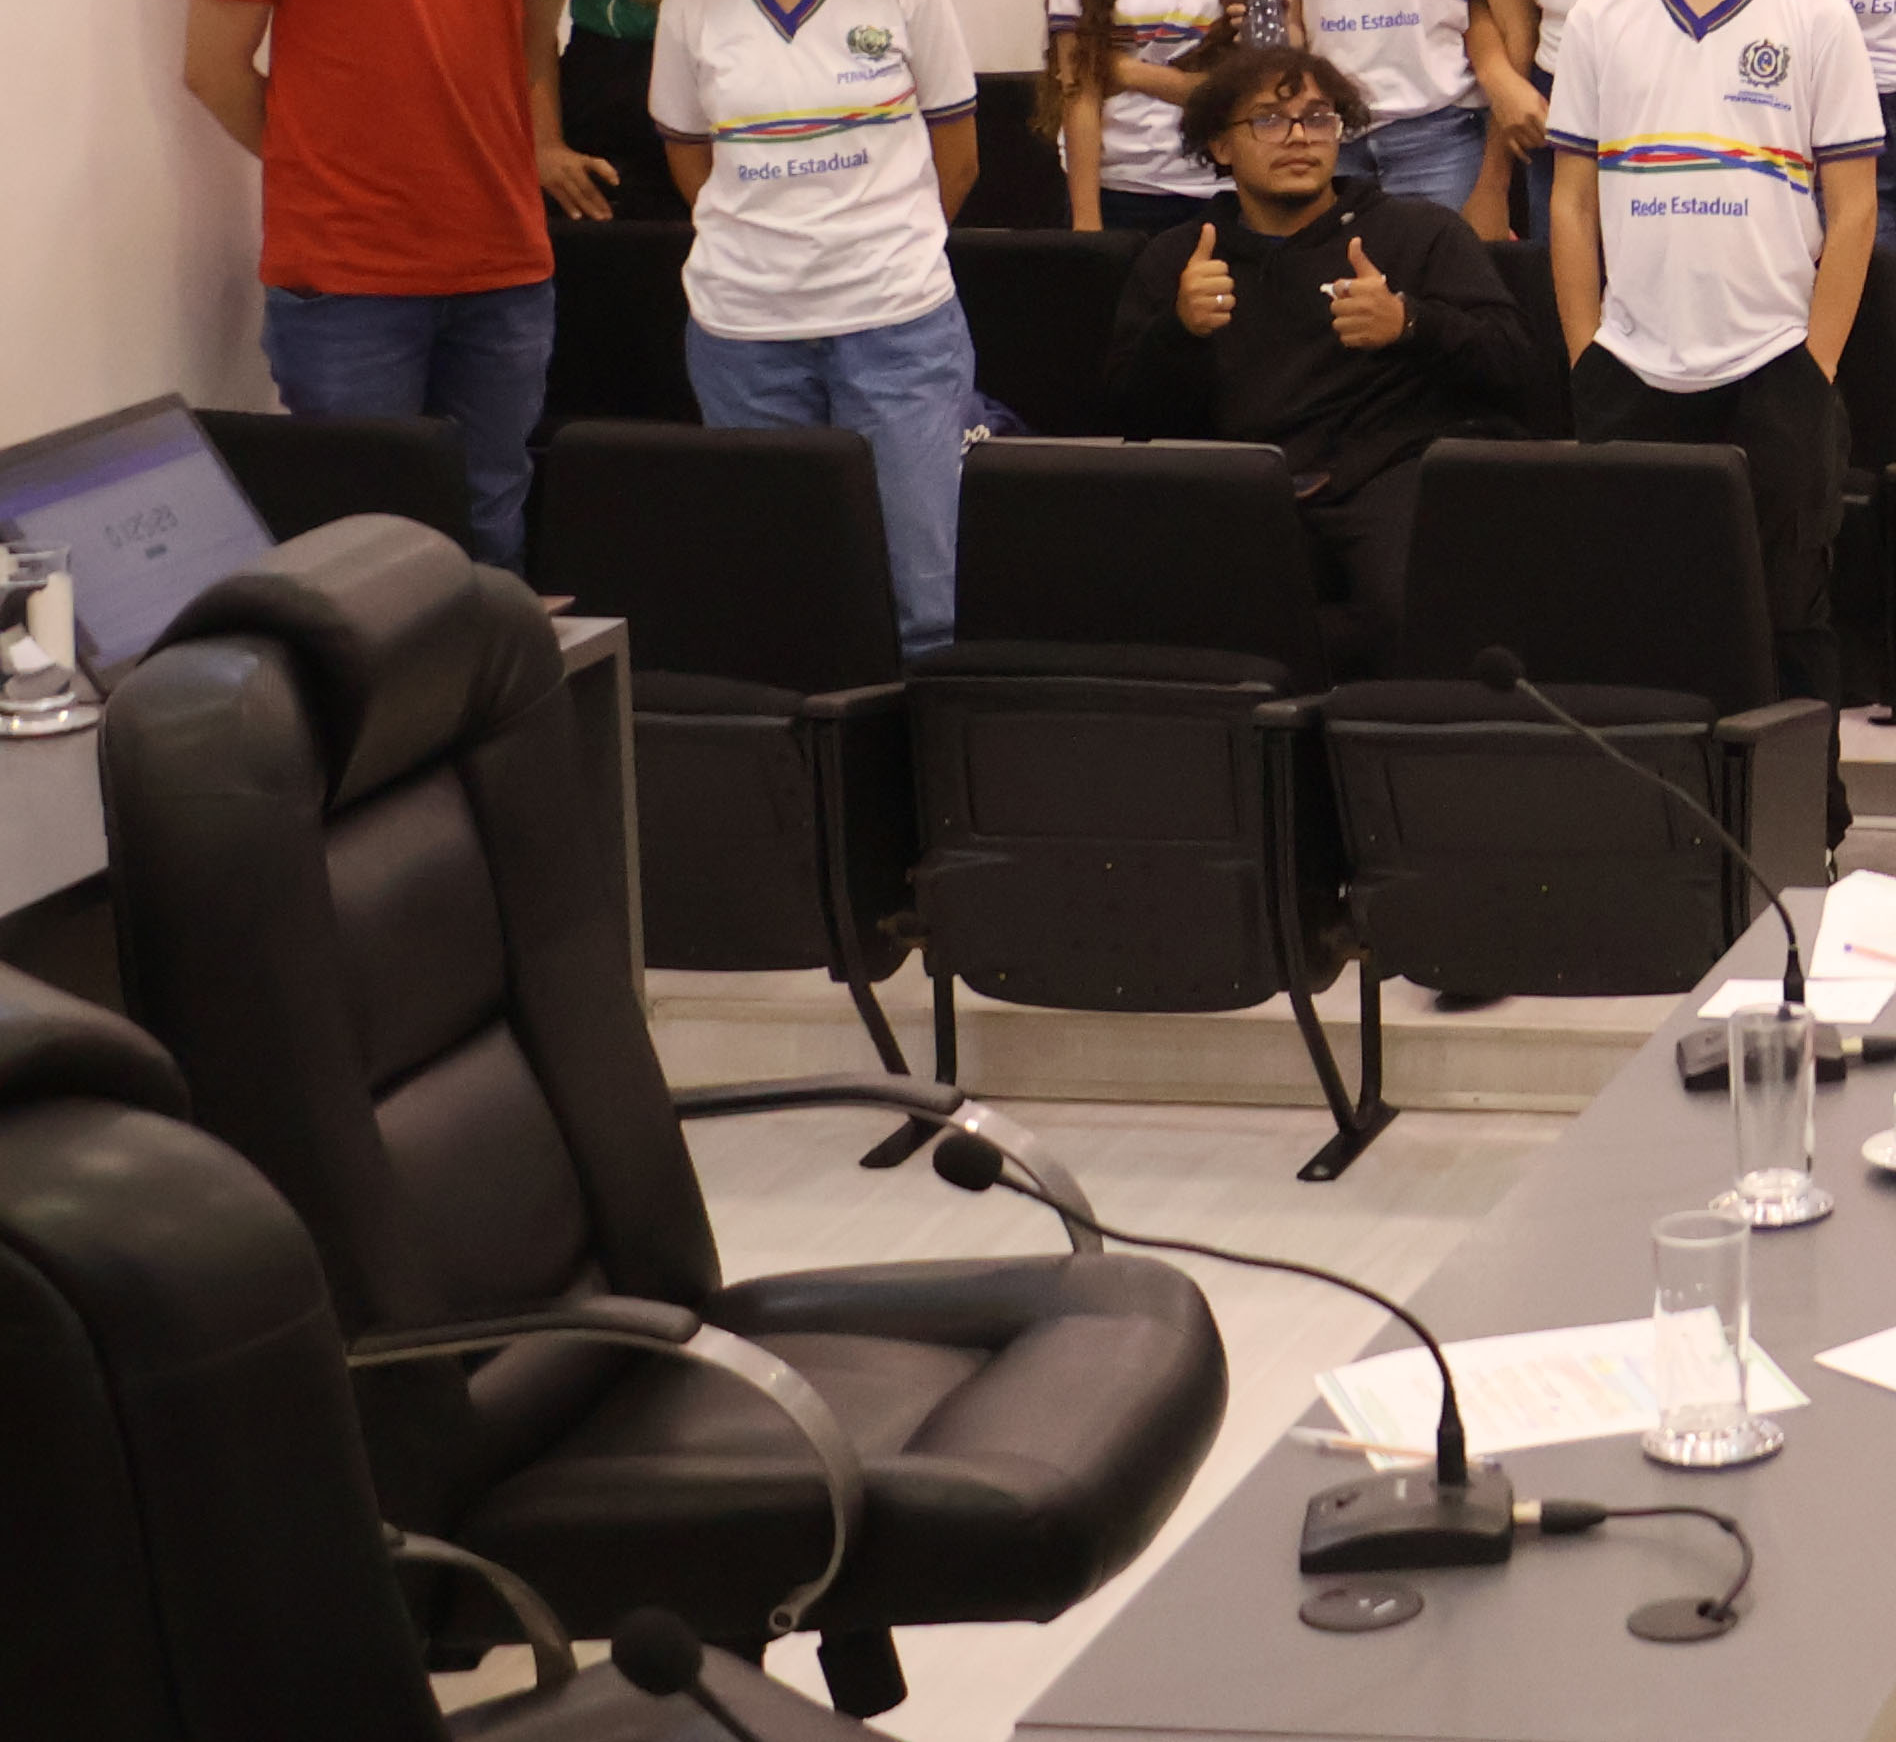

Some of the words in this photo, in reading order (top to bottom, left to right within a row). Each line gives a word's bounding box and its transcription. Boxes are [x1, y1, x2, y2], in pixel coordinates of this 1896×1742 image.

[738, 162, 782, 181] Rede
[787, 148, 869, 177] Estadual
[1631, 197, 1667, 216] Rede
[1671, 196, 1749, 216] Estadual
